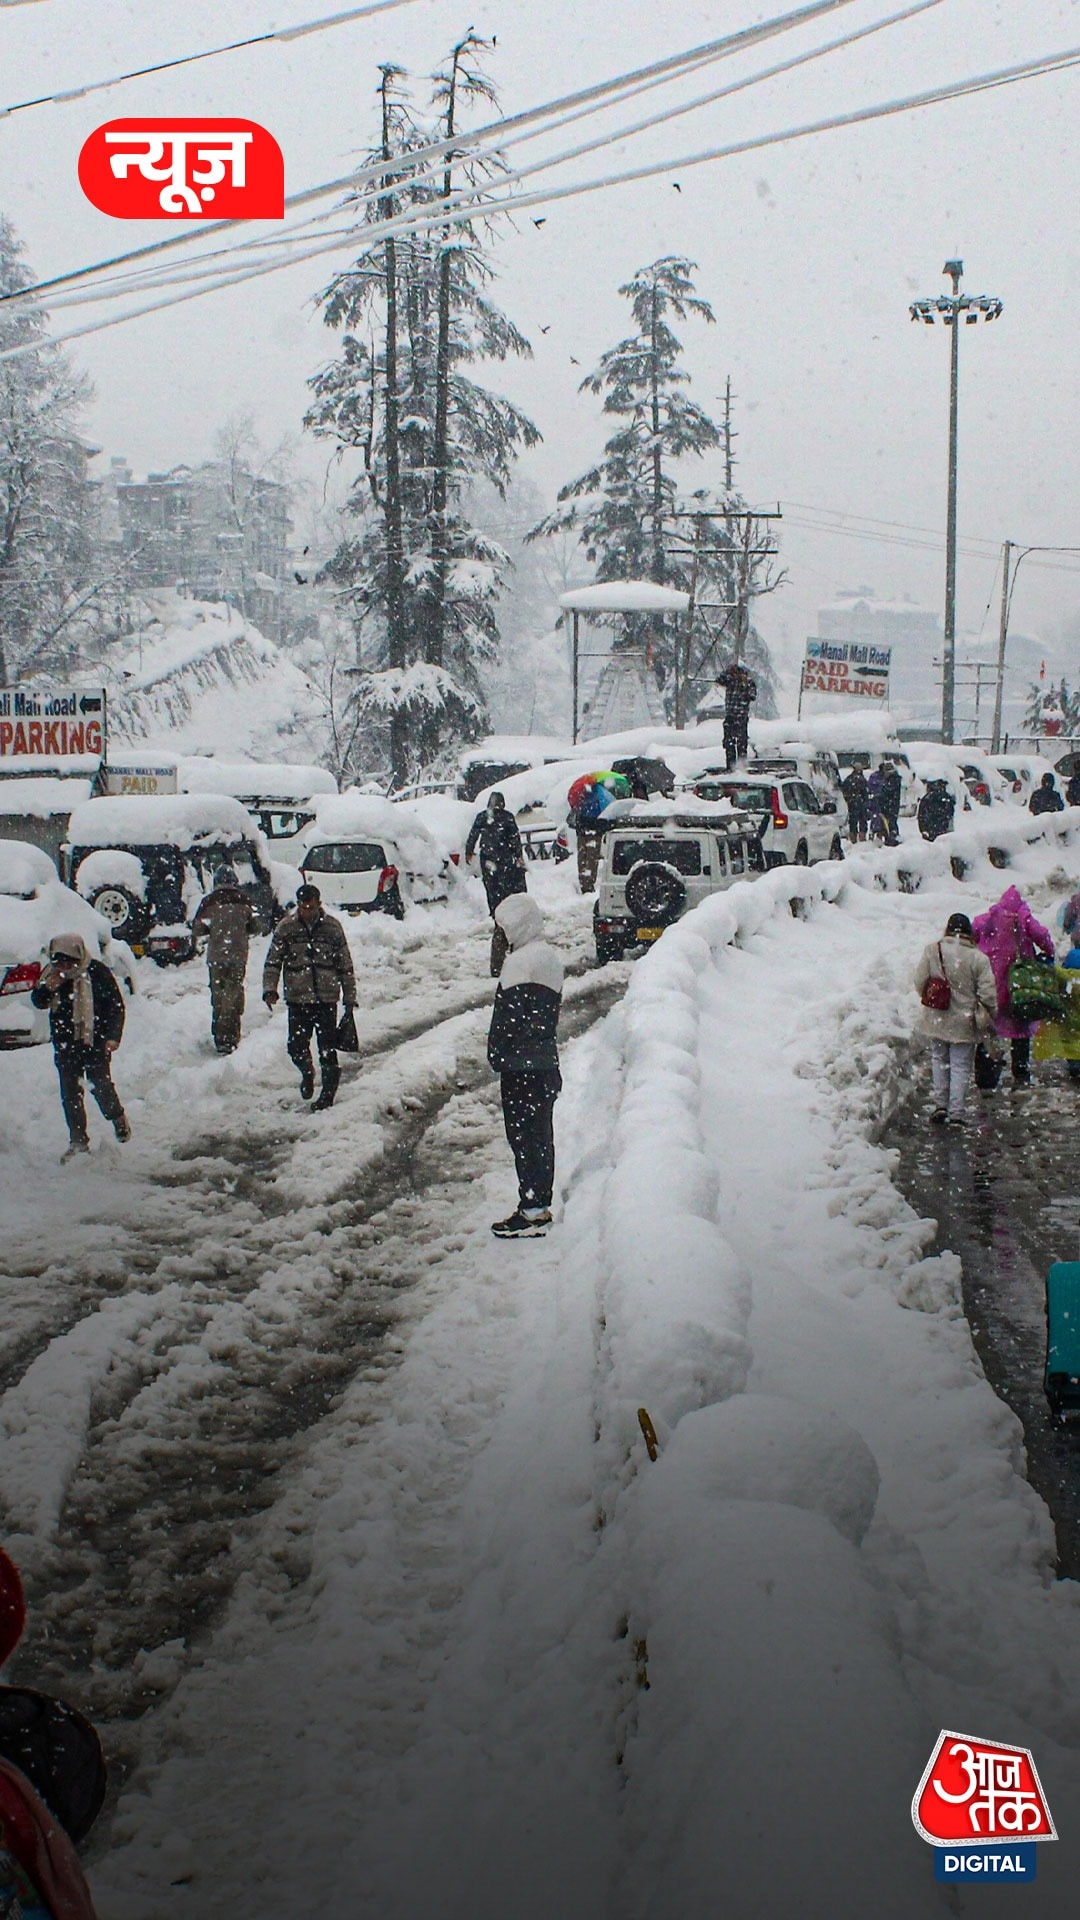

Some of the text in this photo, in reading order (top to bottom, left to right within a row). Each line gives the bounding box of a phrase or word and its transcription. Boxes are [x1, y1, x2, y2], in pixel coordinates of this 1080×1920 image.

[820, 642, 848, 661] Manali
[868, 647, 891, 666] Road
[806, 659, 849, 677] PAID
[804, 675, 886, 697] PARKING
[45, 692, 76, 716] Road
[0, 721, 102, 755] PARKING
[121, 776, 158, 792] PAID
